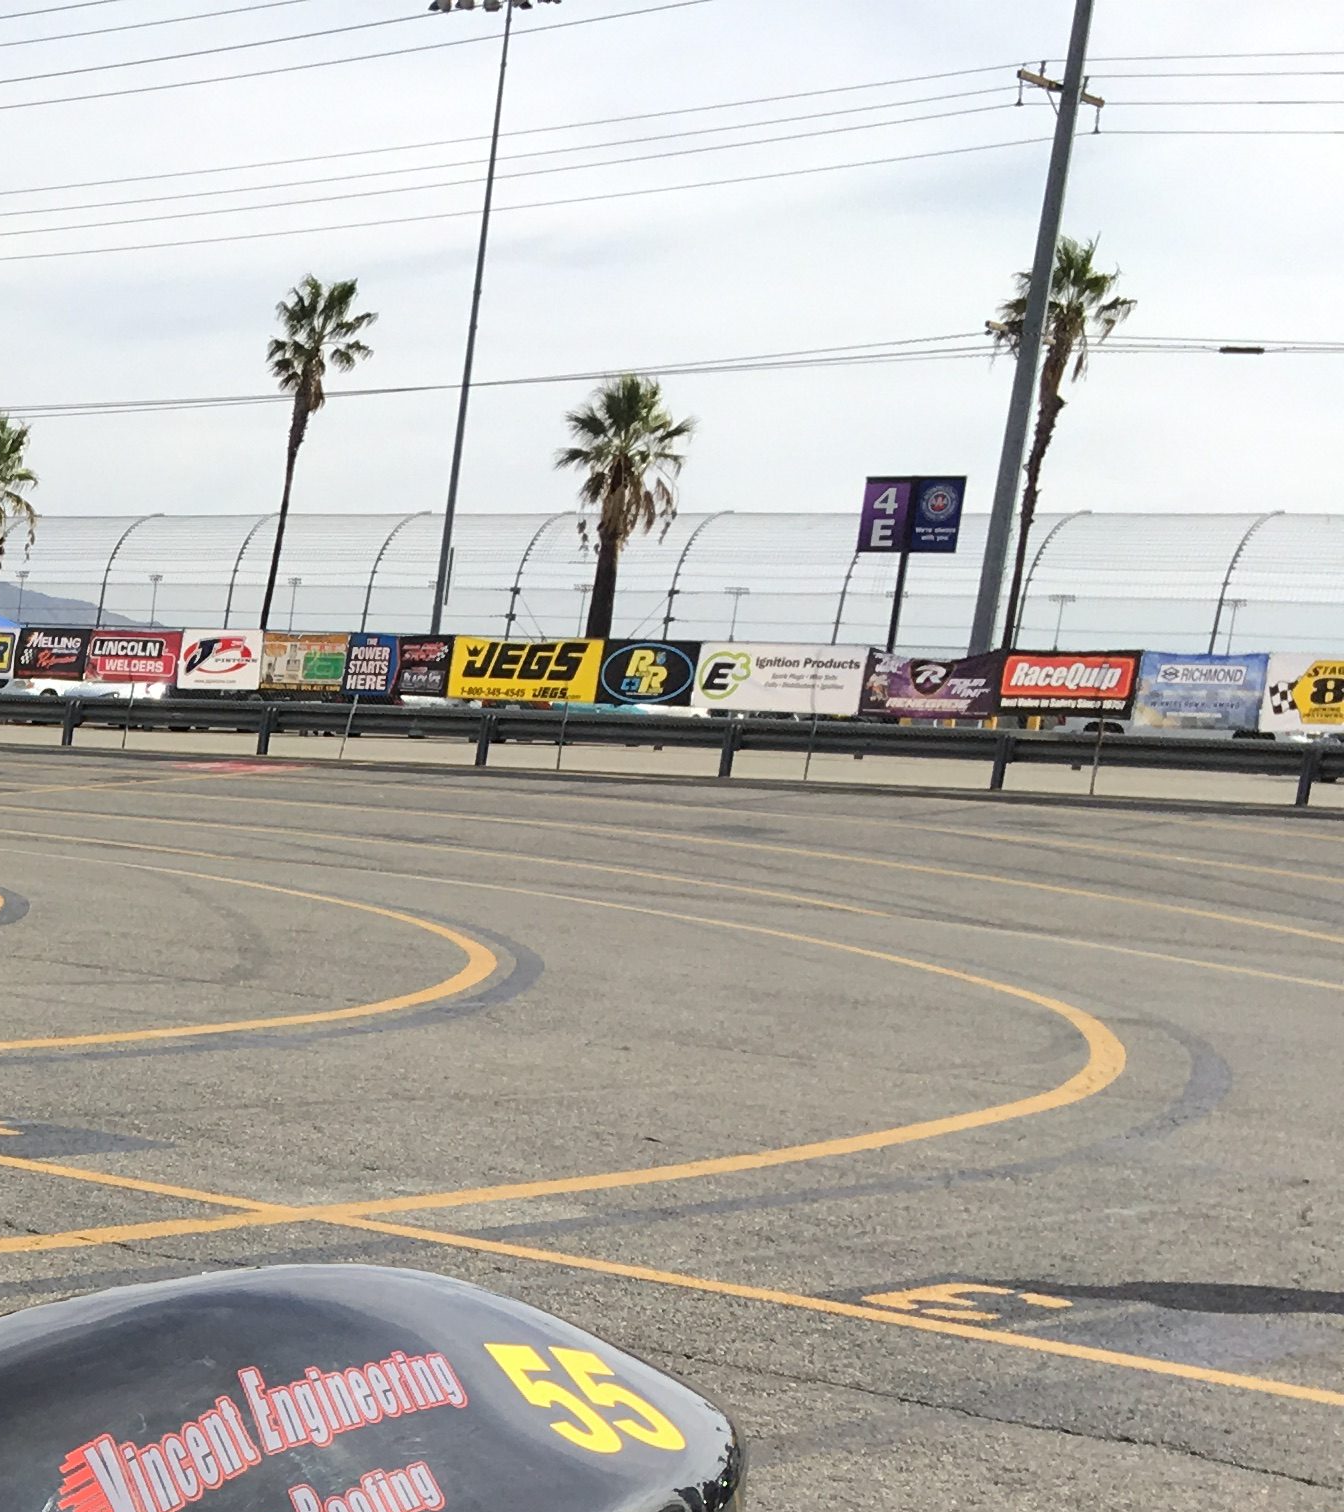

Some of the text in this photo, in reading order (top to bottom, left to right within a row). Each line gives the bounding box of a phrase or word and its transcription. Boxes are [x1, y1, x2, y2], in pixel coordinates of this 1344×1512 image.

[873, 487, 899, 515] 4
[870, 518, 896, 547] E
[26, 631, 82, 649] MELLING
[93, 640, 160, 657] LINCOLN
[350, 646, 391, 660] POWER
[462, 641, 590, 682] JEGS
[104, 659, 164, 673] WELDERS
[348, 660, 389, 674] STARTS
[755, 656, 800, 670] Ignition
[802, 657, 861, 670] Products
[345, 675, 387, 691] HERE
[1010, 662, 1123, 690] RaceQuip
[1180, 667, 1243, 683] RICHMOND
[1309, 677, 1344, 705] 8
[238, 1350, 467, 1455] Engineering
[484, 1343, 686, 1454] 55
